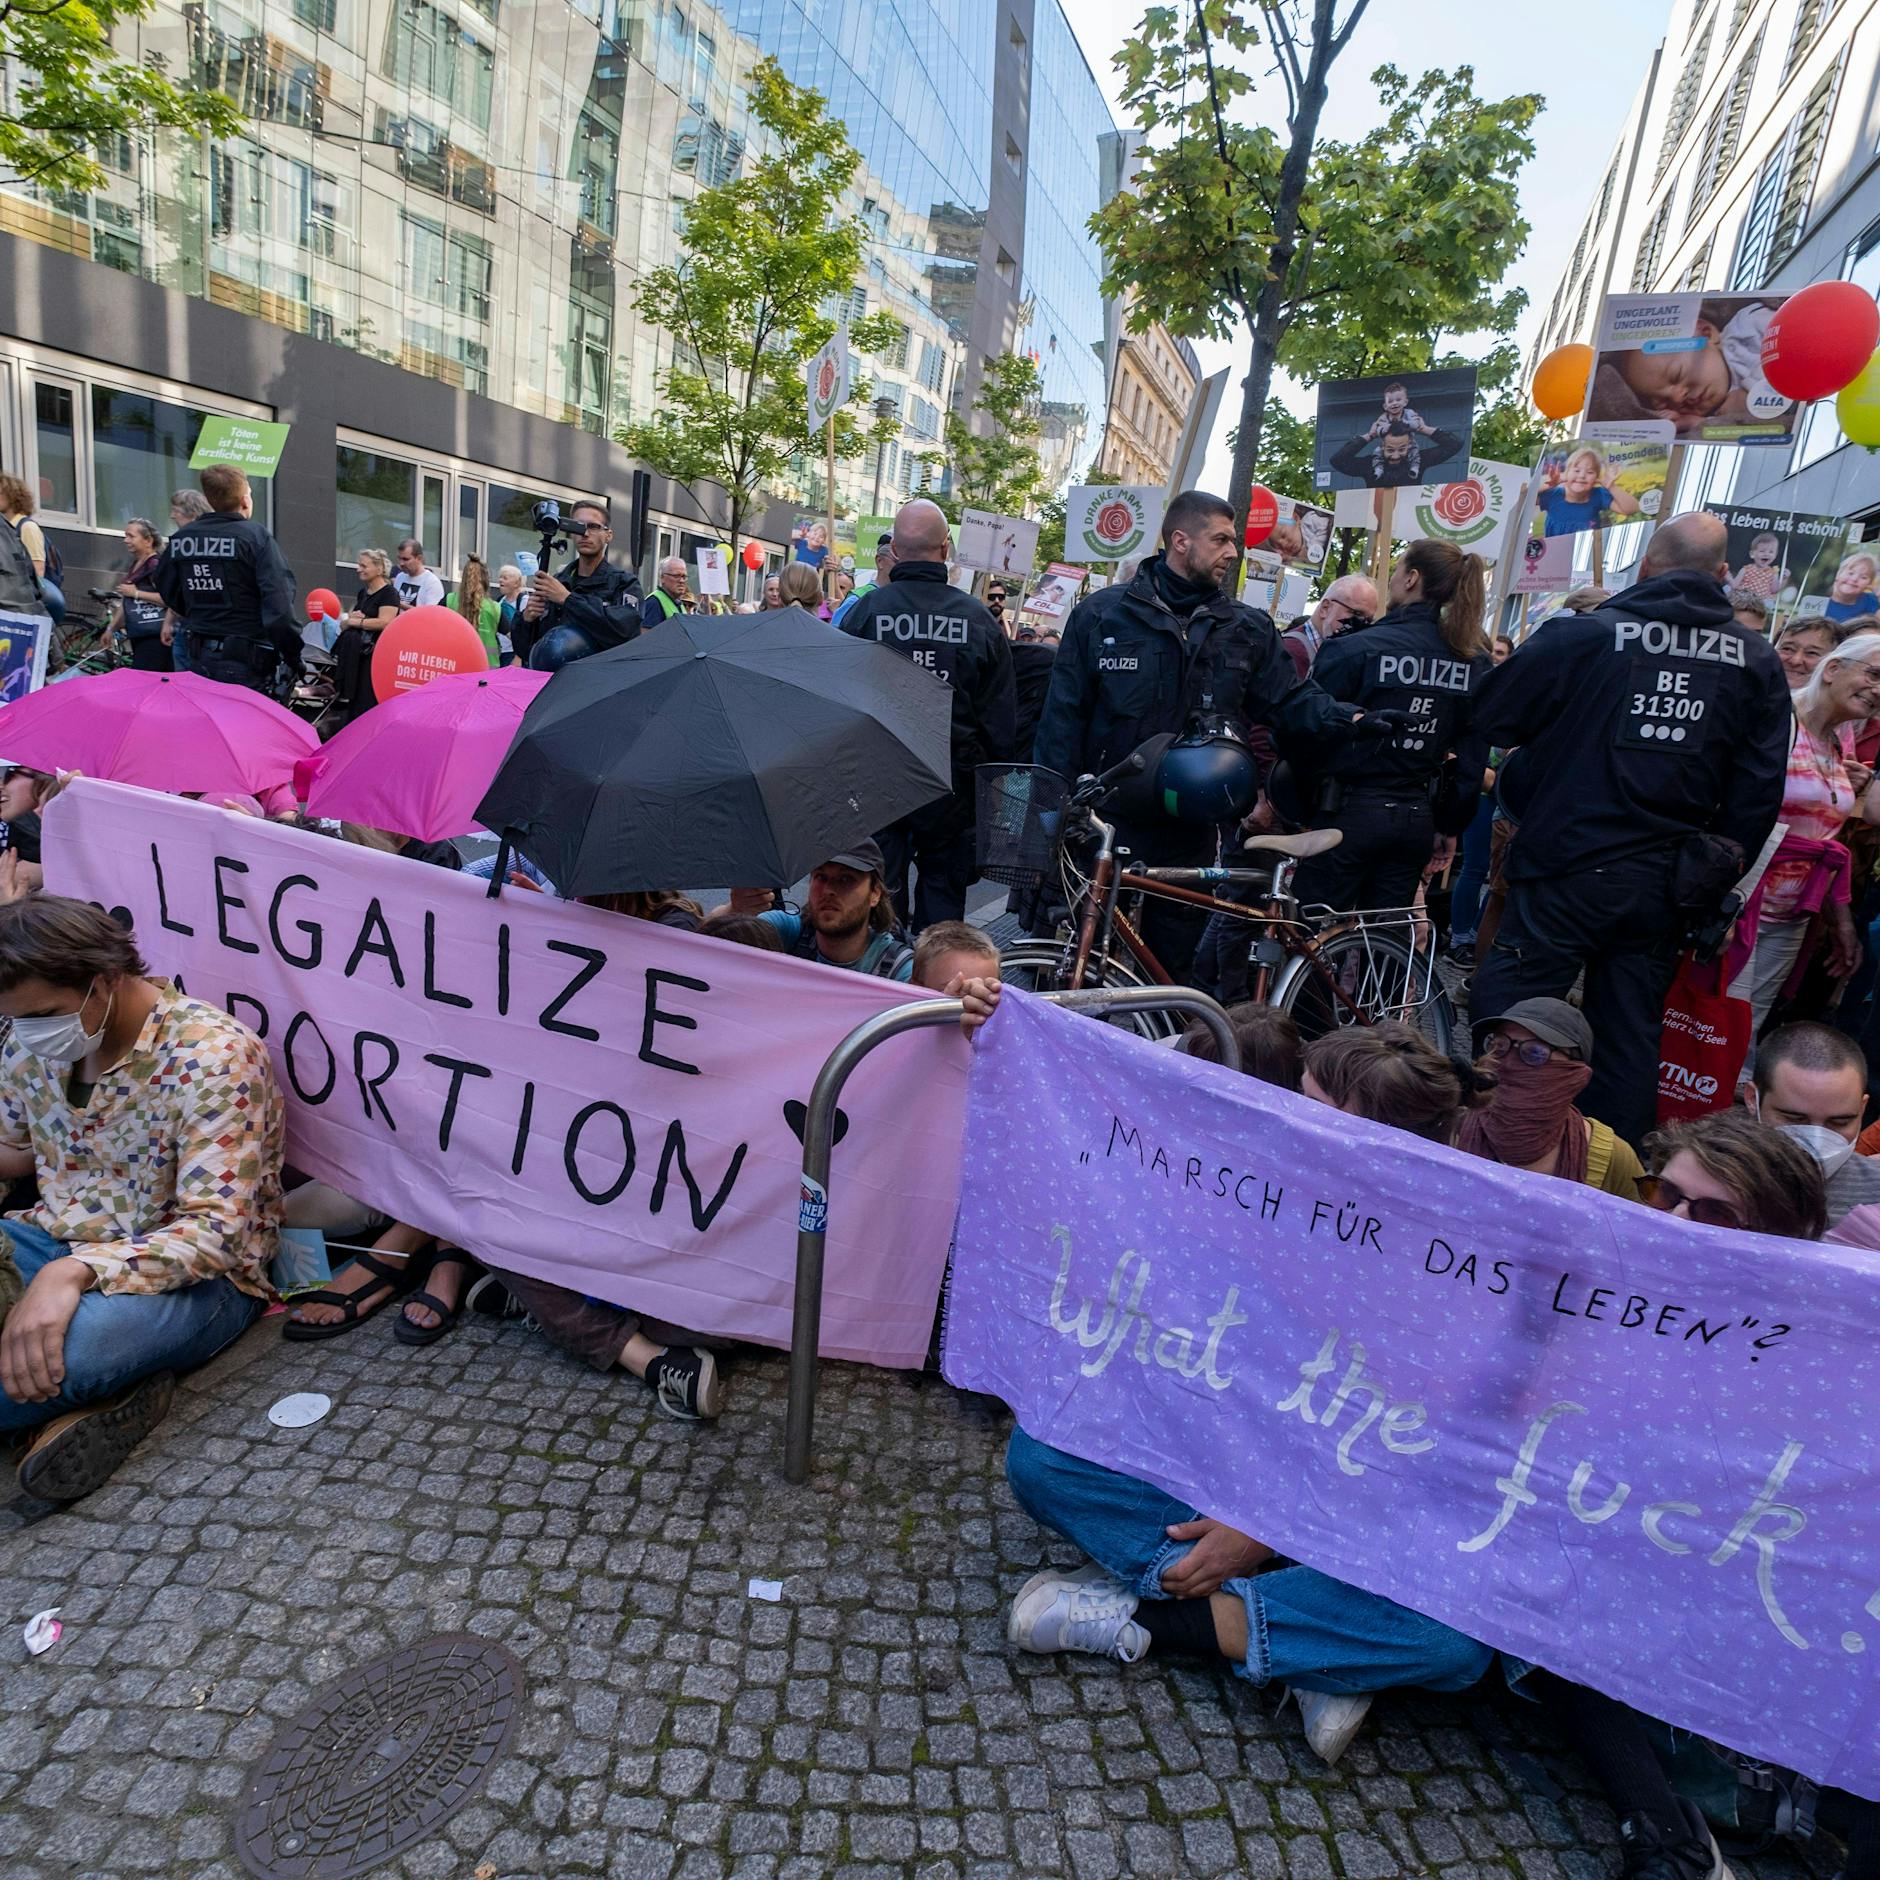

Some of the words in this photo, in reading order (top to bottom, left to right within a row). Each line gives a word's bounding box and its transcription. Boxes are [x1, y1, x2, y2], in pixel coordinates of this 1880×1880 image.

[1615, 305, 1681, 319] UNGEPLANT.
[1613, 316, 1681, 330] UNGEWOLLT.
[218, 437, 231, 447] ist
[233, 438, 262, 451] keine
[1608, 444, 1667, 463] besonders!
[198, 447, 243, 461] ärztliche
[246, 452, 275, 464] Kunst
[1470, 462, 1488, 476] OU
[1486, 474, 1503, 512] MOM!
[1084, 489, 1114, 525] DANKE
[1117, 489, 1145, 525] MAMA!
[1731, 511, 1769, 531] Leben
[1773, 516, 1794, 532] ist
[1797, 521, 1846, 538] schön!
[170, 537, 235, 558] POLIZEI
[193, 564, 211, 577] BE
[186, 578, 223, 591] 31214
[876, 613, 968, 644] POLIZEI
[1614, 620, 1746, 668] POLIZEI
[399, 650, 418, 665] WIR
[421, 654, 456, 672] LIEBEN
[912, 650, 936, 667] BE
[1099, 657, 1138, 670] POLIZEI
[397, 665, 416, 679] DAS
[1378, 655, 1471, 692] POLIZEI
[1656, 670, 1691, 694] BE
[1409, 696, 1434, 715] BE
[1630, 693, 1705, 721] 31300
[151, 843, 710, 1075] LEGALIZE
[1662, 1018, 1688, 1032] Herz
[1671, 1083, 1712, 1104] Fernsehen
[1310, 1201, 1383, 1254] FÜR
[1424, 1238, 1514, 1296] DAS
[1049, 1224, 1249, 1391] What
[1276, 1327, 1436, 1477] the
